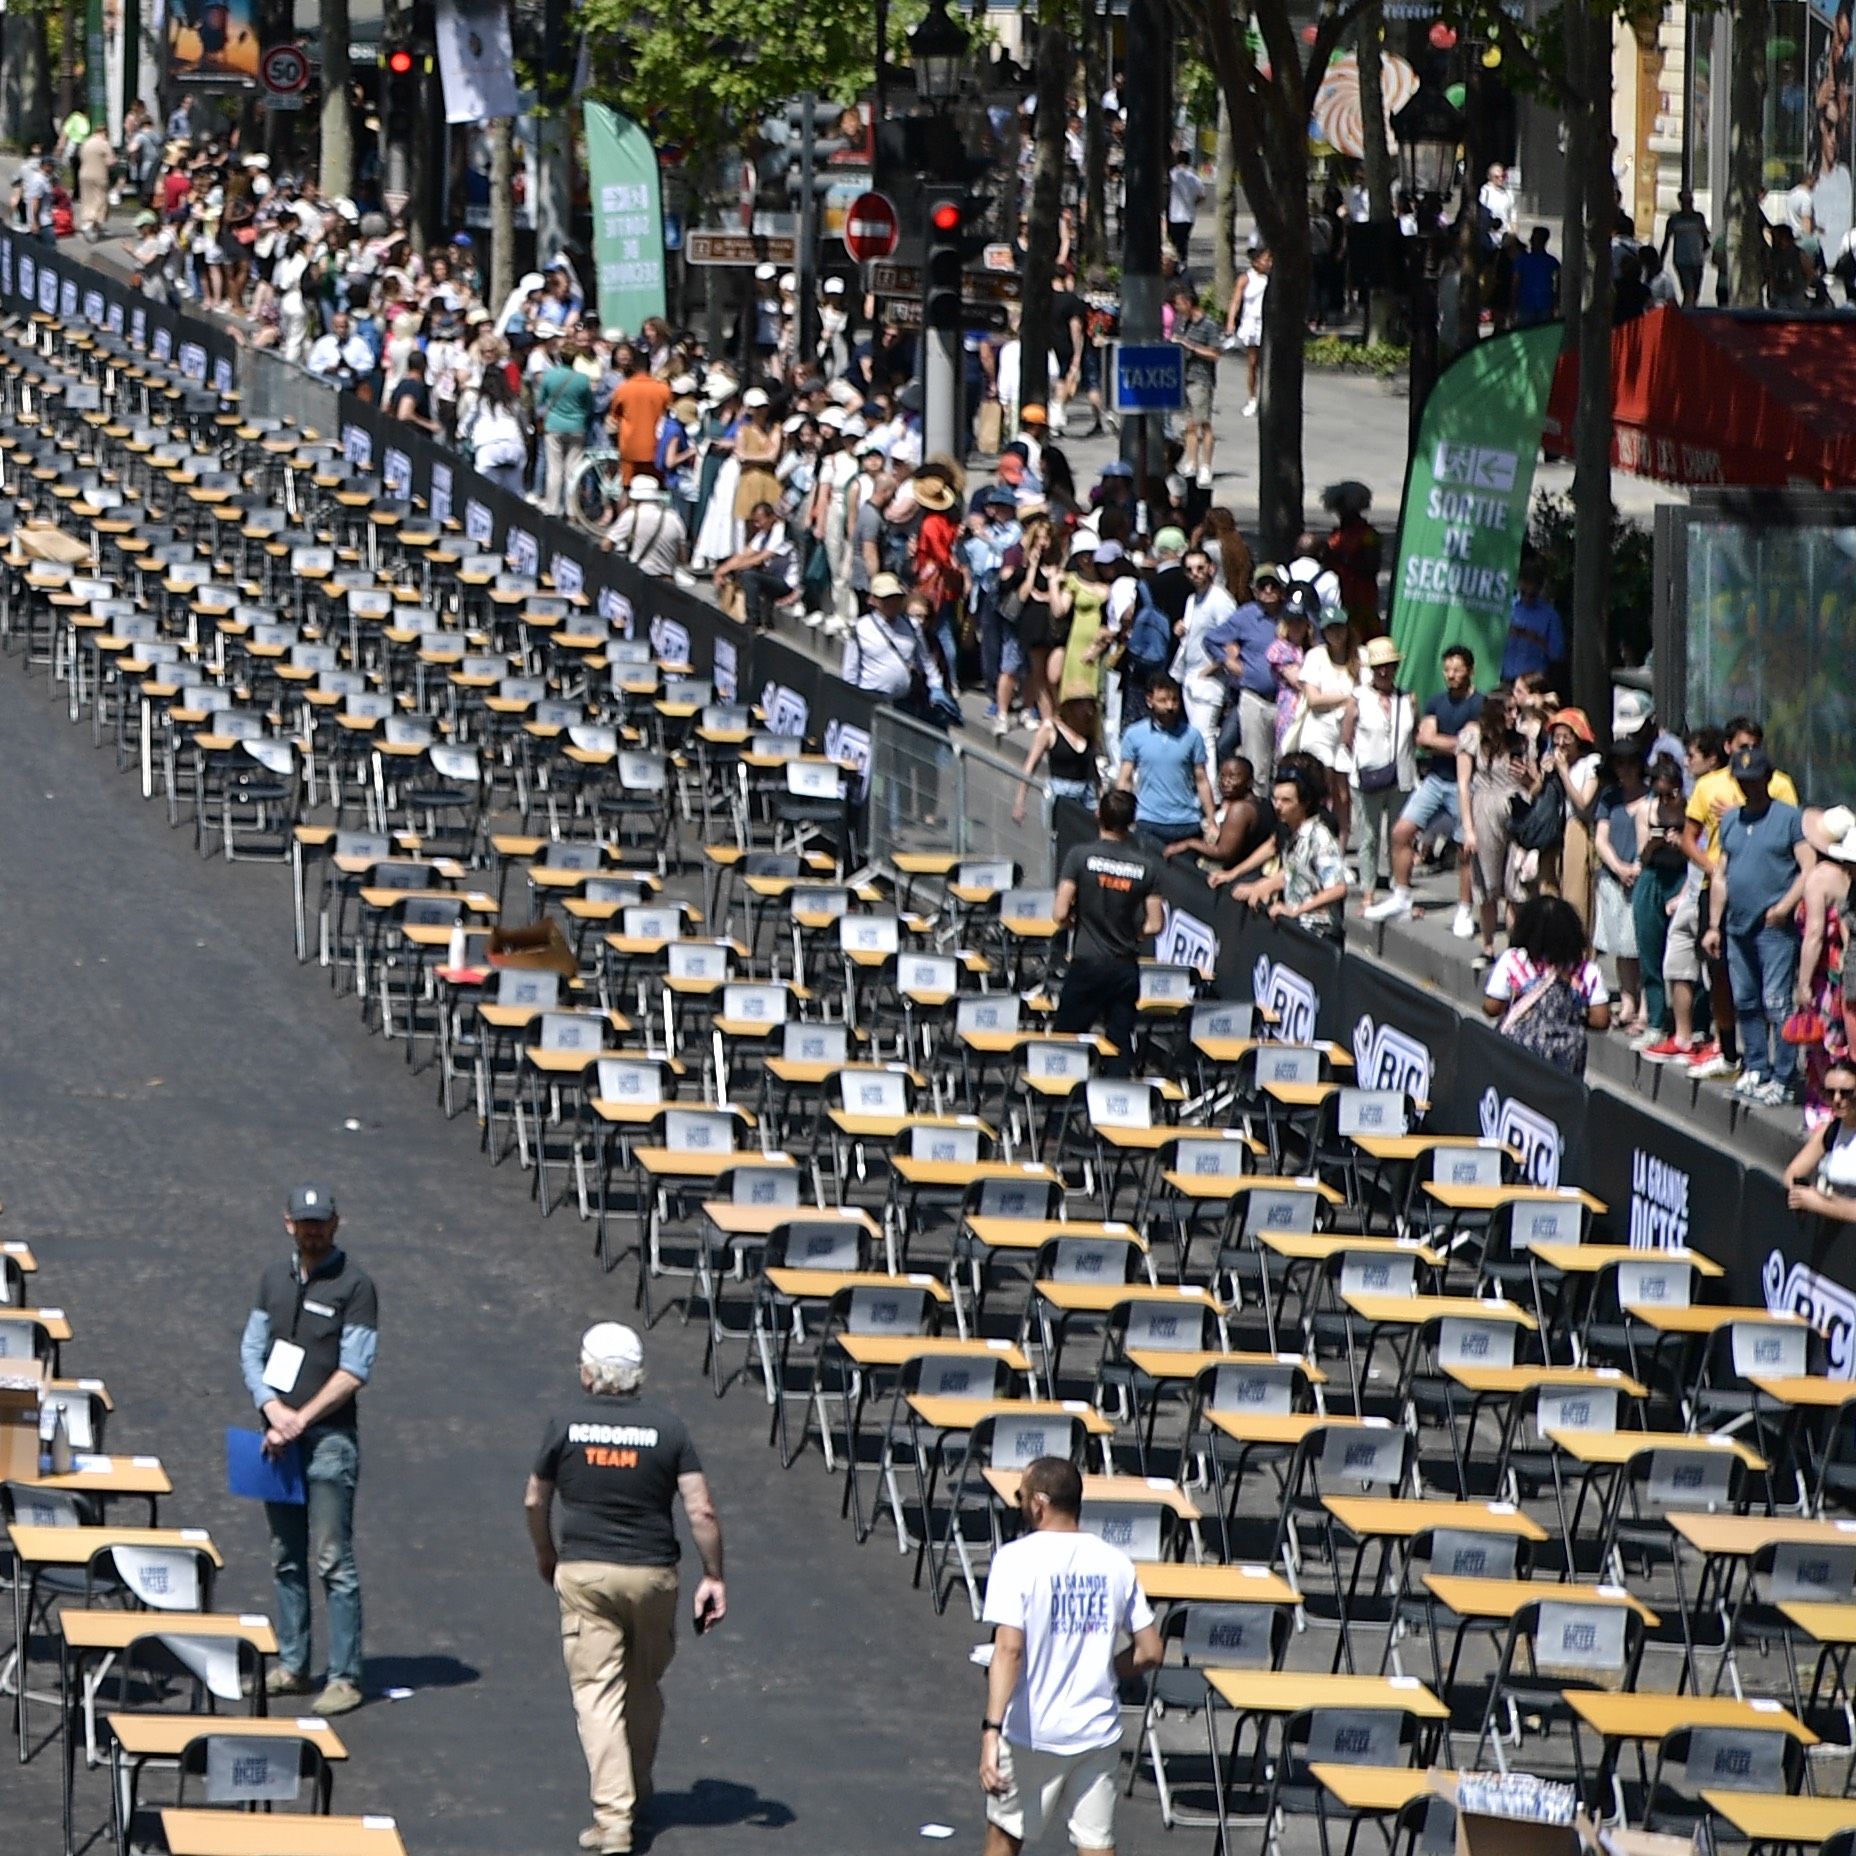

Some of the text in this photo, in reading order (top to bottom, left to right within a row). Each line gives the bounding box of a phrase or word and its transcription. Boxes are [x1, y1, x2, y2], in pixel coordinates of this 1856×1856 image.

[271, 61, 296, 81] 50
[1120, 367, 1177, 390] TAXIS
[1427, 486, 1509, 530] SORTIE
[1443, 525, 1475, 561] DE
[1405, 554, 1509, 601] SECOURS
[1098, 873, 1132, 892] TEAM
[1633, 1147, 1689, 1218] LA GRANDE
[1631, 1194, 1689, 1251] DICTÉE
[569, 1423, 659, 1448] ACADOMIA
[585, 1447, 639, 1468] TEAM
[1050, 1573, 1108, 1593] LA GRANDE
[1051, 1591, 1109, 1616] DICTÉE
